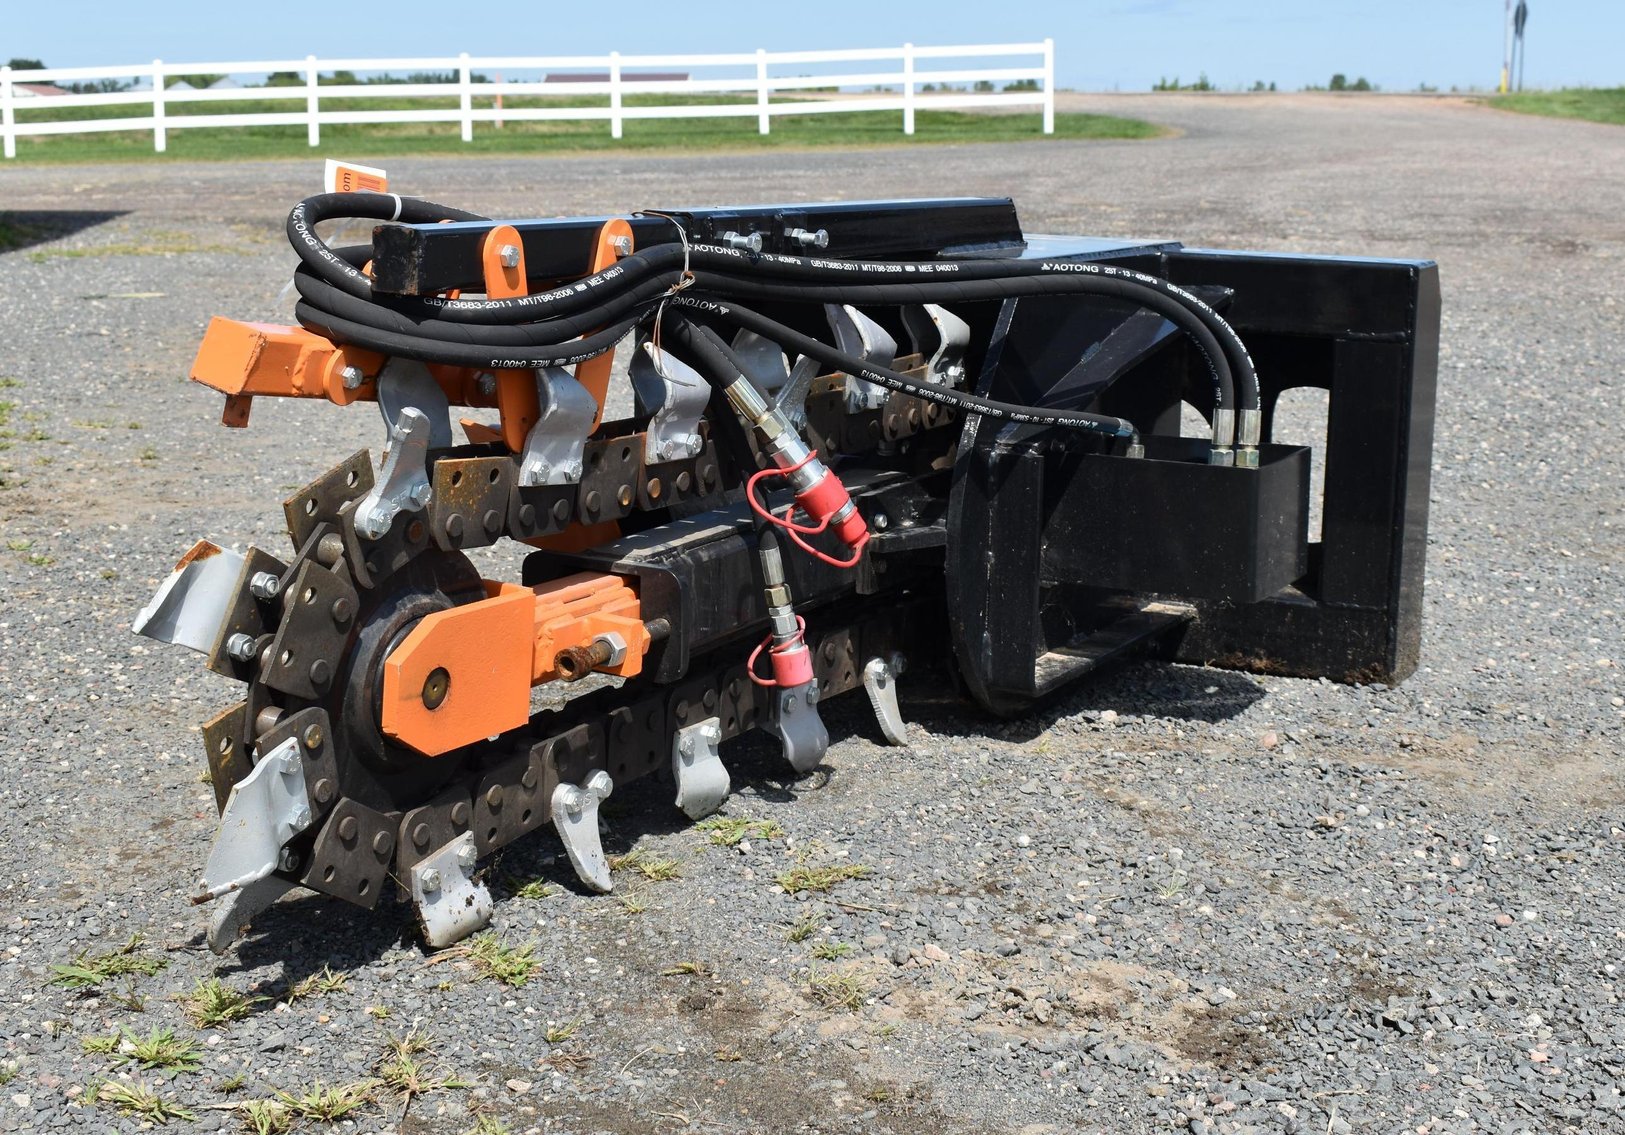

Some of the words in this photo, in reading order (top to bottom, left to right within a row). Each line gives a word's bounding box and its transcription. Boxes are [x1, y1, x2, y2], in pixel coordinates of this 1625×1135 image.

[319, 249, 341, 263] 2ST
[694, 244, 740, 257] AOTONG
[936, 264, 959, 272] 040013
[1053, 263, 1099, 273] AOTONG
[423, 296, 512, 310] GB/T3683-2011
[587, 274, 605, 288] MEE
[603, 266, 624, 281] 040013
[672, 296, 717, 311] AOTONG
[491, 359, 526, 368] 040013
[530, 360, 551, 368] MEE
[860, 369, 886, 384] 040013
[886, 378, 904, 389] MEE
[1057, 417, 1092, 428] AOTONG
